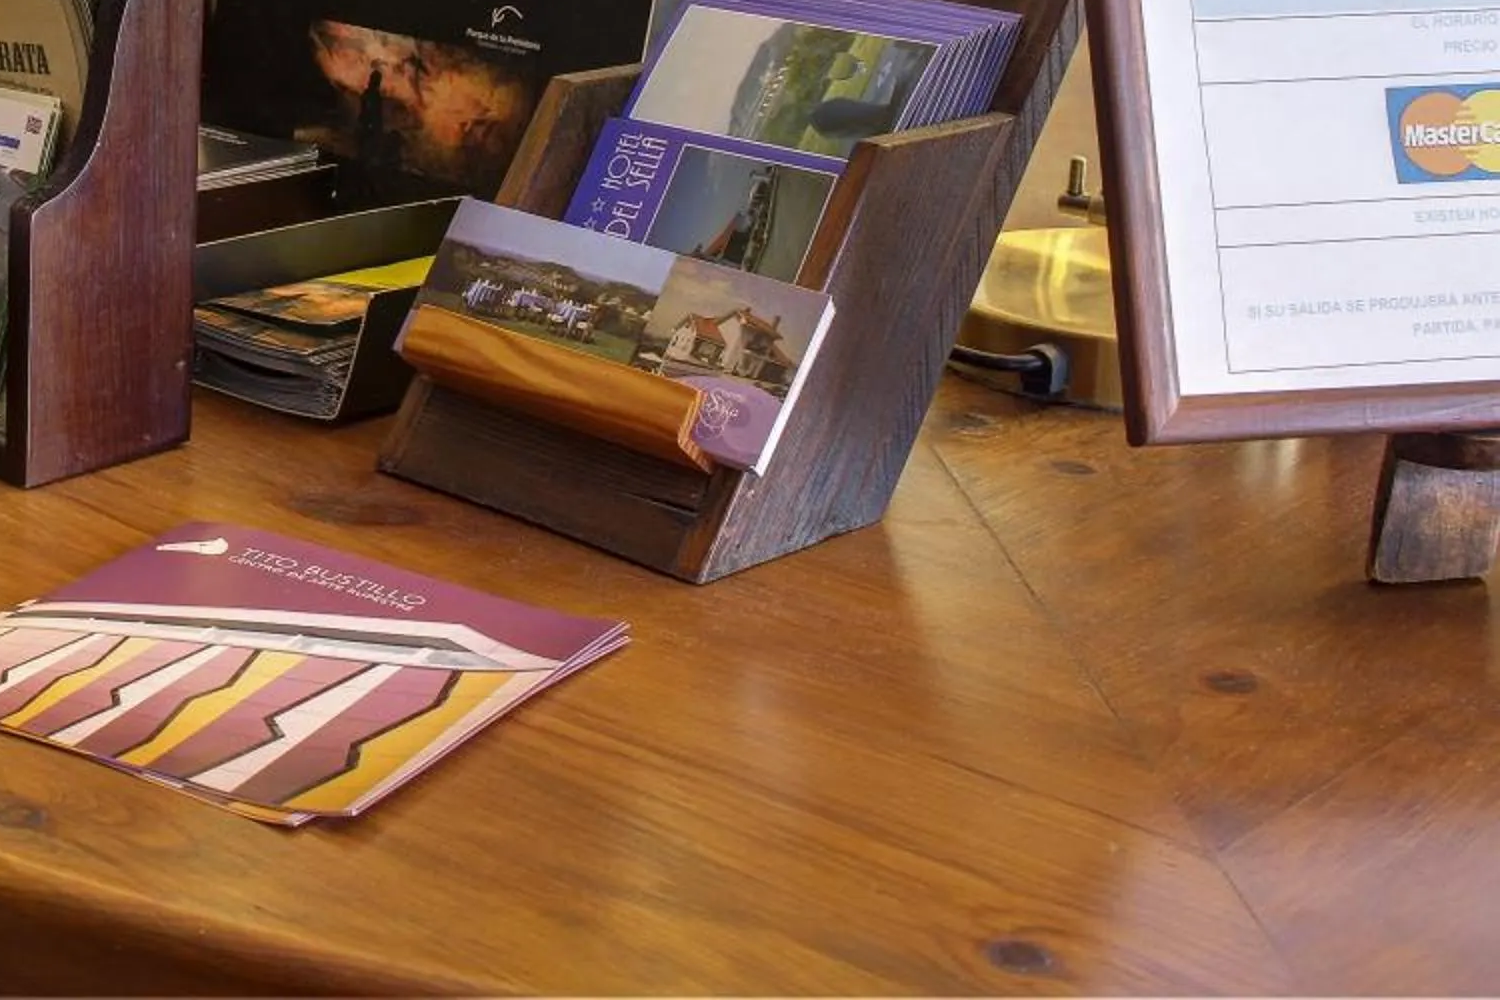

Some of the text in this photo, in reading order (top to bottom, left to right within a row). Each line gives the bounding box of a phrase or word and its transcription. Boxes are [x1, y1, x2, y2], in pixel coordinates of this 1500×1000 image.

[1433, 11, 1498, 28] HORARIO
[1444, 38, 1498, 54] PRECIO
[601, 132, 643, 191] HOTEL
[603, 136, 669, 239] DEL SELLA
[1413, 207, 1475, 224] EXISTEN
[1265, 300, 1286, 318] SU
[1289, 298, 1342, 316] SALIDA
[1346, 298, 1365, 312] SE
[242, 547, 427, 606] TITO BUSTILLO
